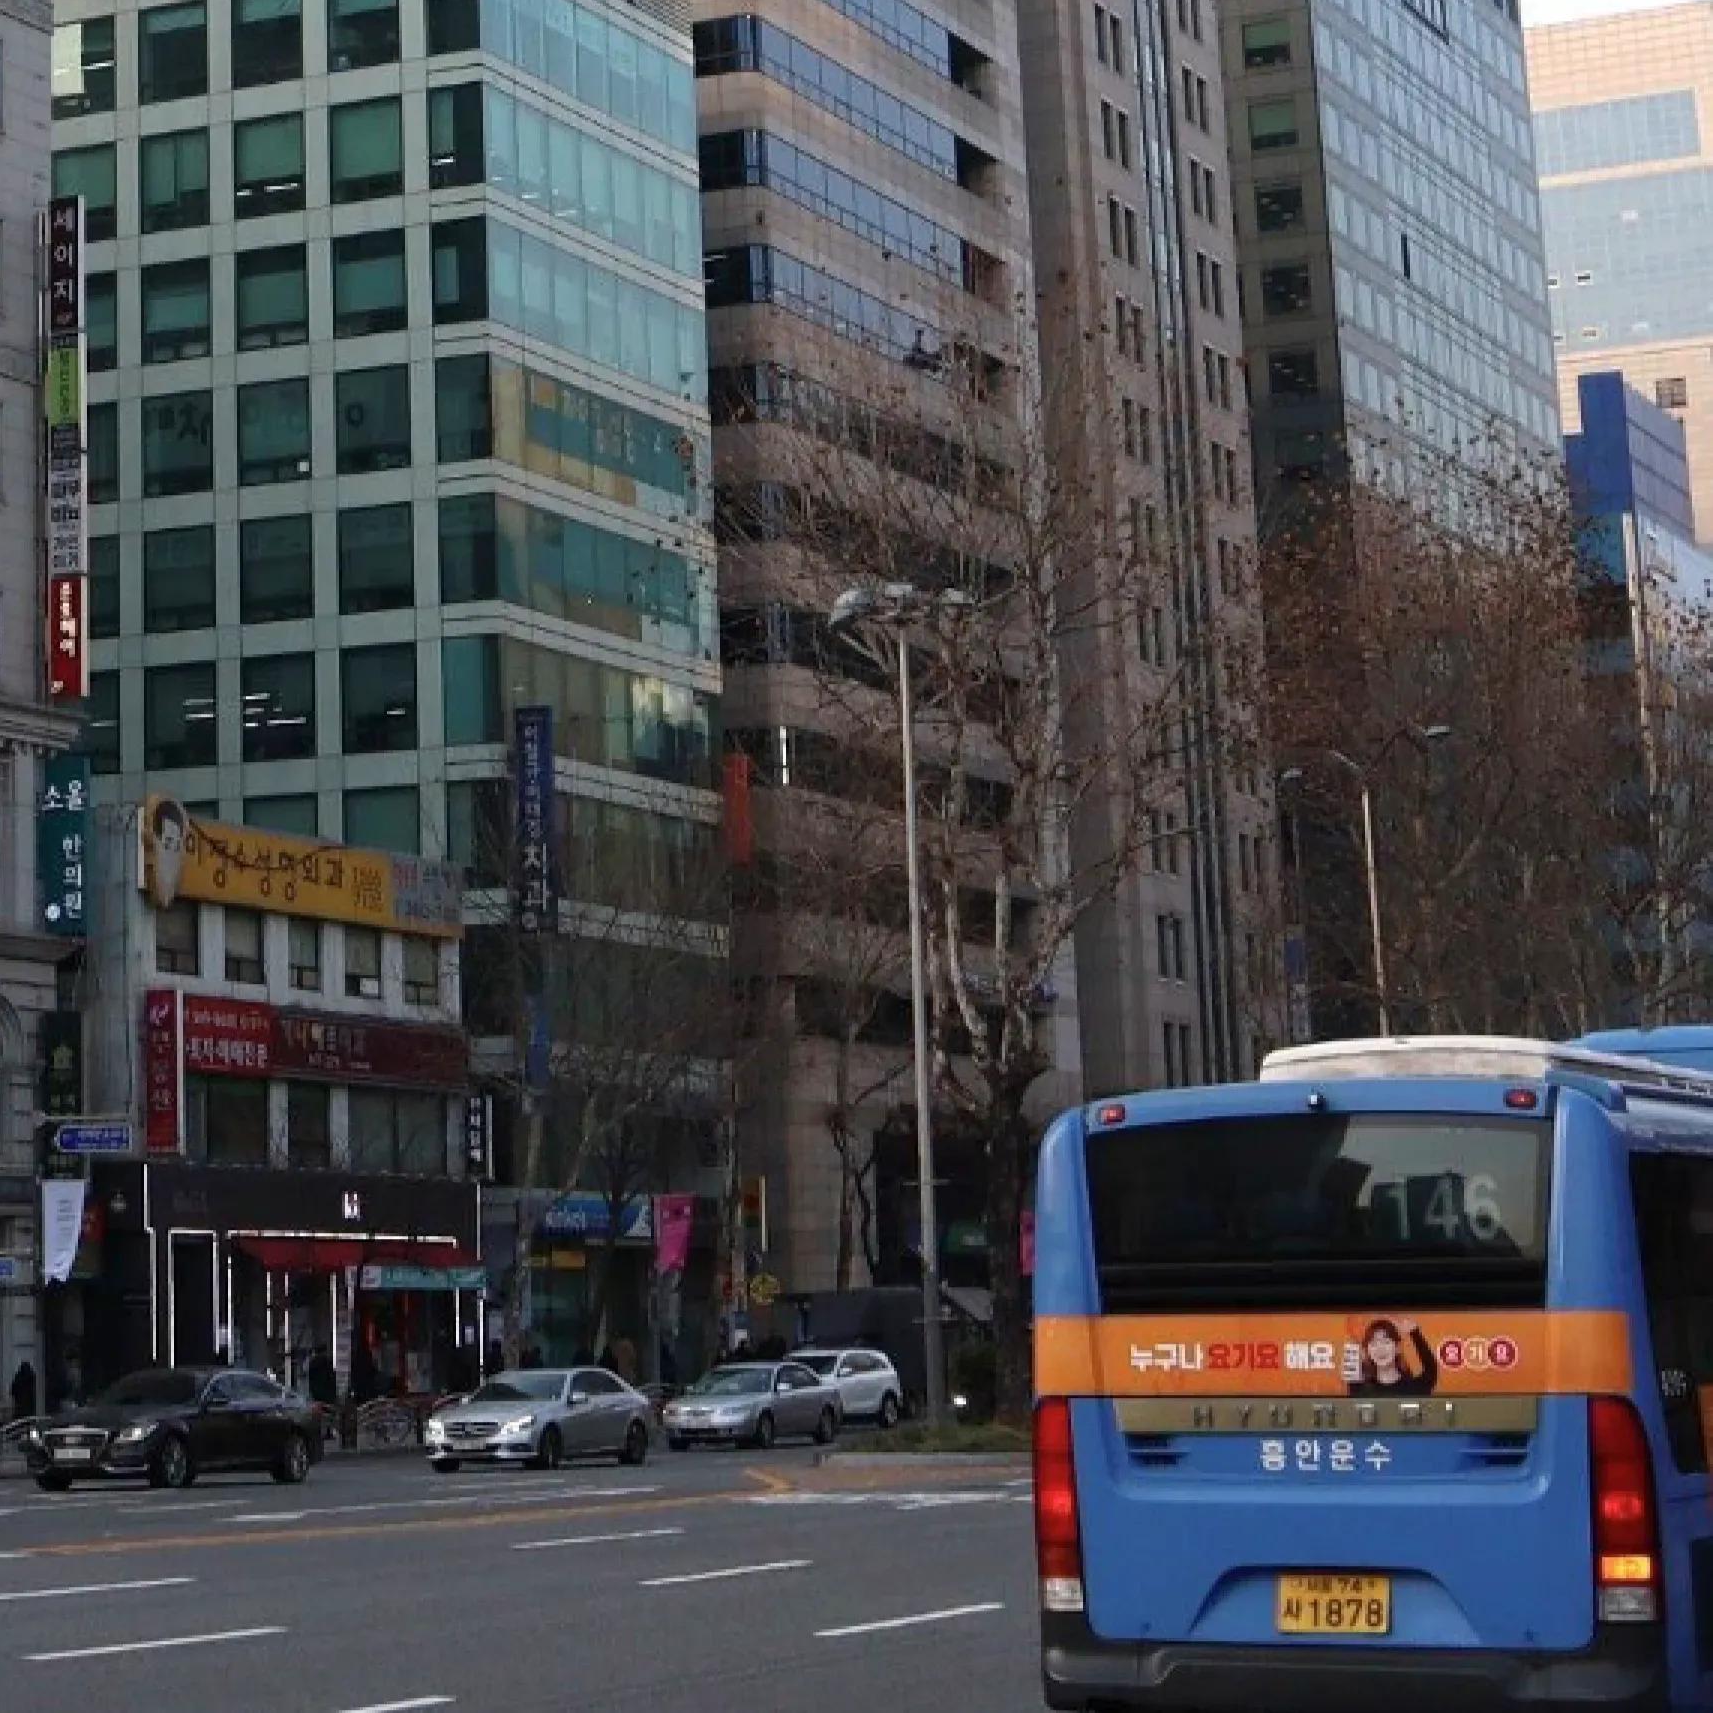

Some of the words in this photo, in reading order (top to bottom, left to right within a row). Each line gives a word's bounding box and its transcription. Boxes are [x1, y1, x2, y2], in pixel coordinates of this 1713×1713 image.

[1130, 1342, 1205, 1373] 누구나
[1208, 1343, 1280, 1370] 요기요
[1283, 1341, 1336, 1371] 해요
[1260, 1438, 1393, 1471] 흥안운수
